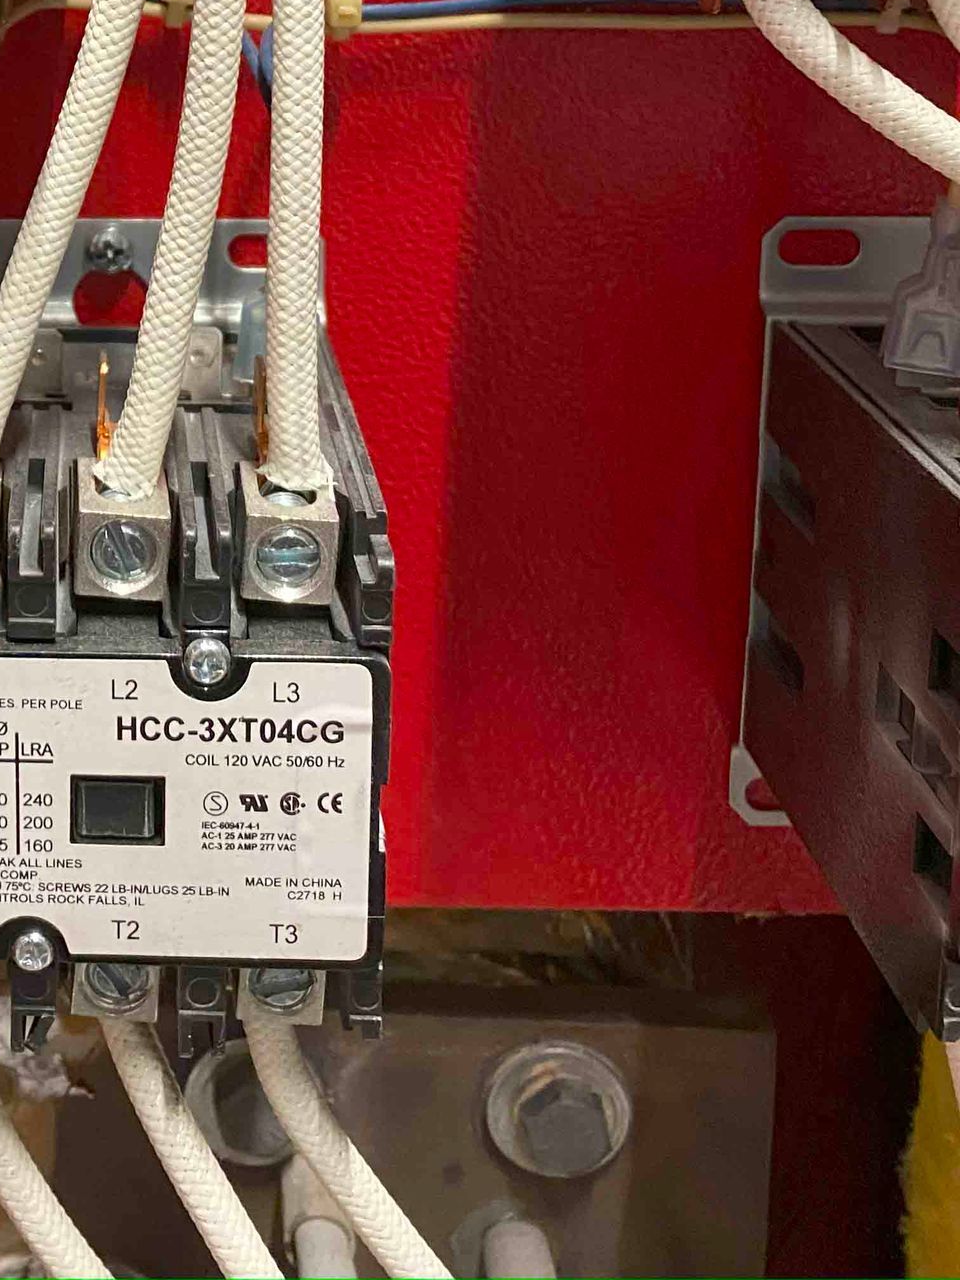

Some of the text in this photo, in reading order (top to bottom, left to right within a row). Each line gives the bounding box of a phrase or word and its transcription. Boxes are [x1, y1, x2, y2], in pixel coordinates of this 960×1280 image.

[111, 679, 139, 700] L2
[273, 682, 300, 703] L3
[116, 716, 345, 744] HCC-3XT04CG
[21, 743, 54, 757] LRA
[185, 754, 345, 768] COIL 120 VAC 50/60 Hz
[23, 793, 53, 807] 240
[23, 816, 53, 830] 200
[24, 839, 54, 853] 160
[19, 858, 42, 868] ALL
[46, 858, 83, 869] LINES
[245, 877, 342, 888] MADE IN CHINA
[48, 894, 84, 905] ROCK
[134, 897, 145, 906] IL
[287, 891, 342, 901] C2718 H
[111, 920, 140, 940] T2
[269, 924, 299, 944] T3
